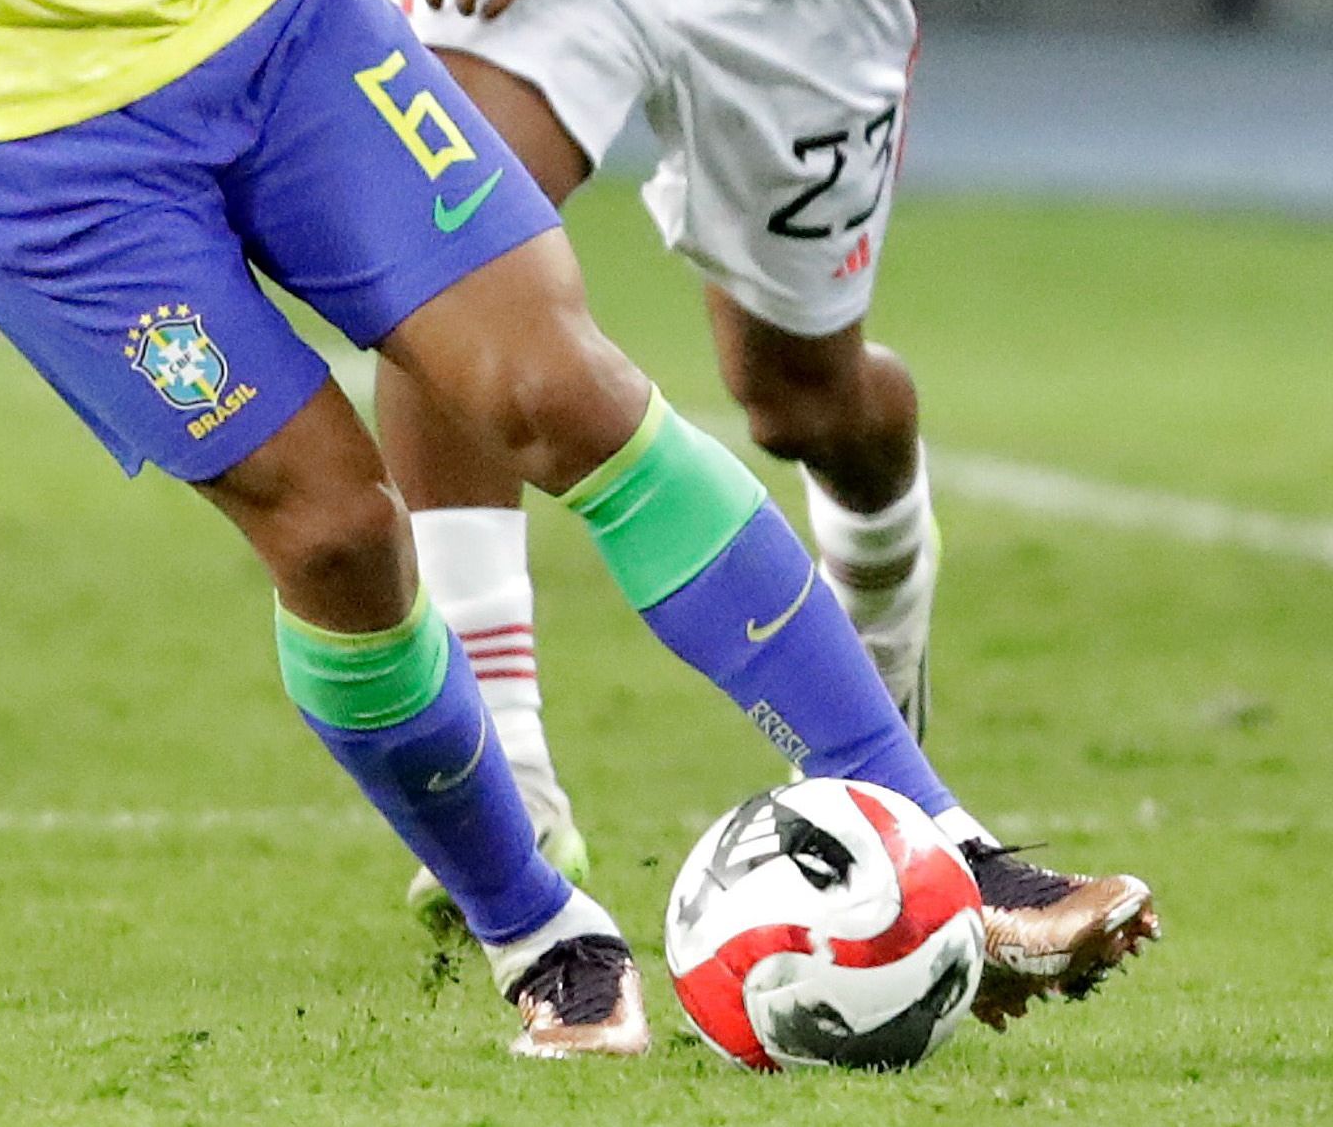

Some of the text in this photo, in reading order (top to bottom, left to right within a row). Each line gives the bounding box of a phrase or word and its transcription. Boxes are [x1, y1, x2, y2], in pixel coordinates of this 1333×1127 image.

[353, 49, 477, 181] 6
[767, 102, 896, 240] 23
[187, 383, 258, 440] BRASIL
